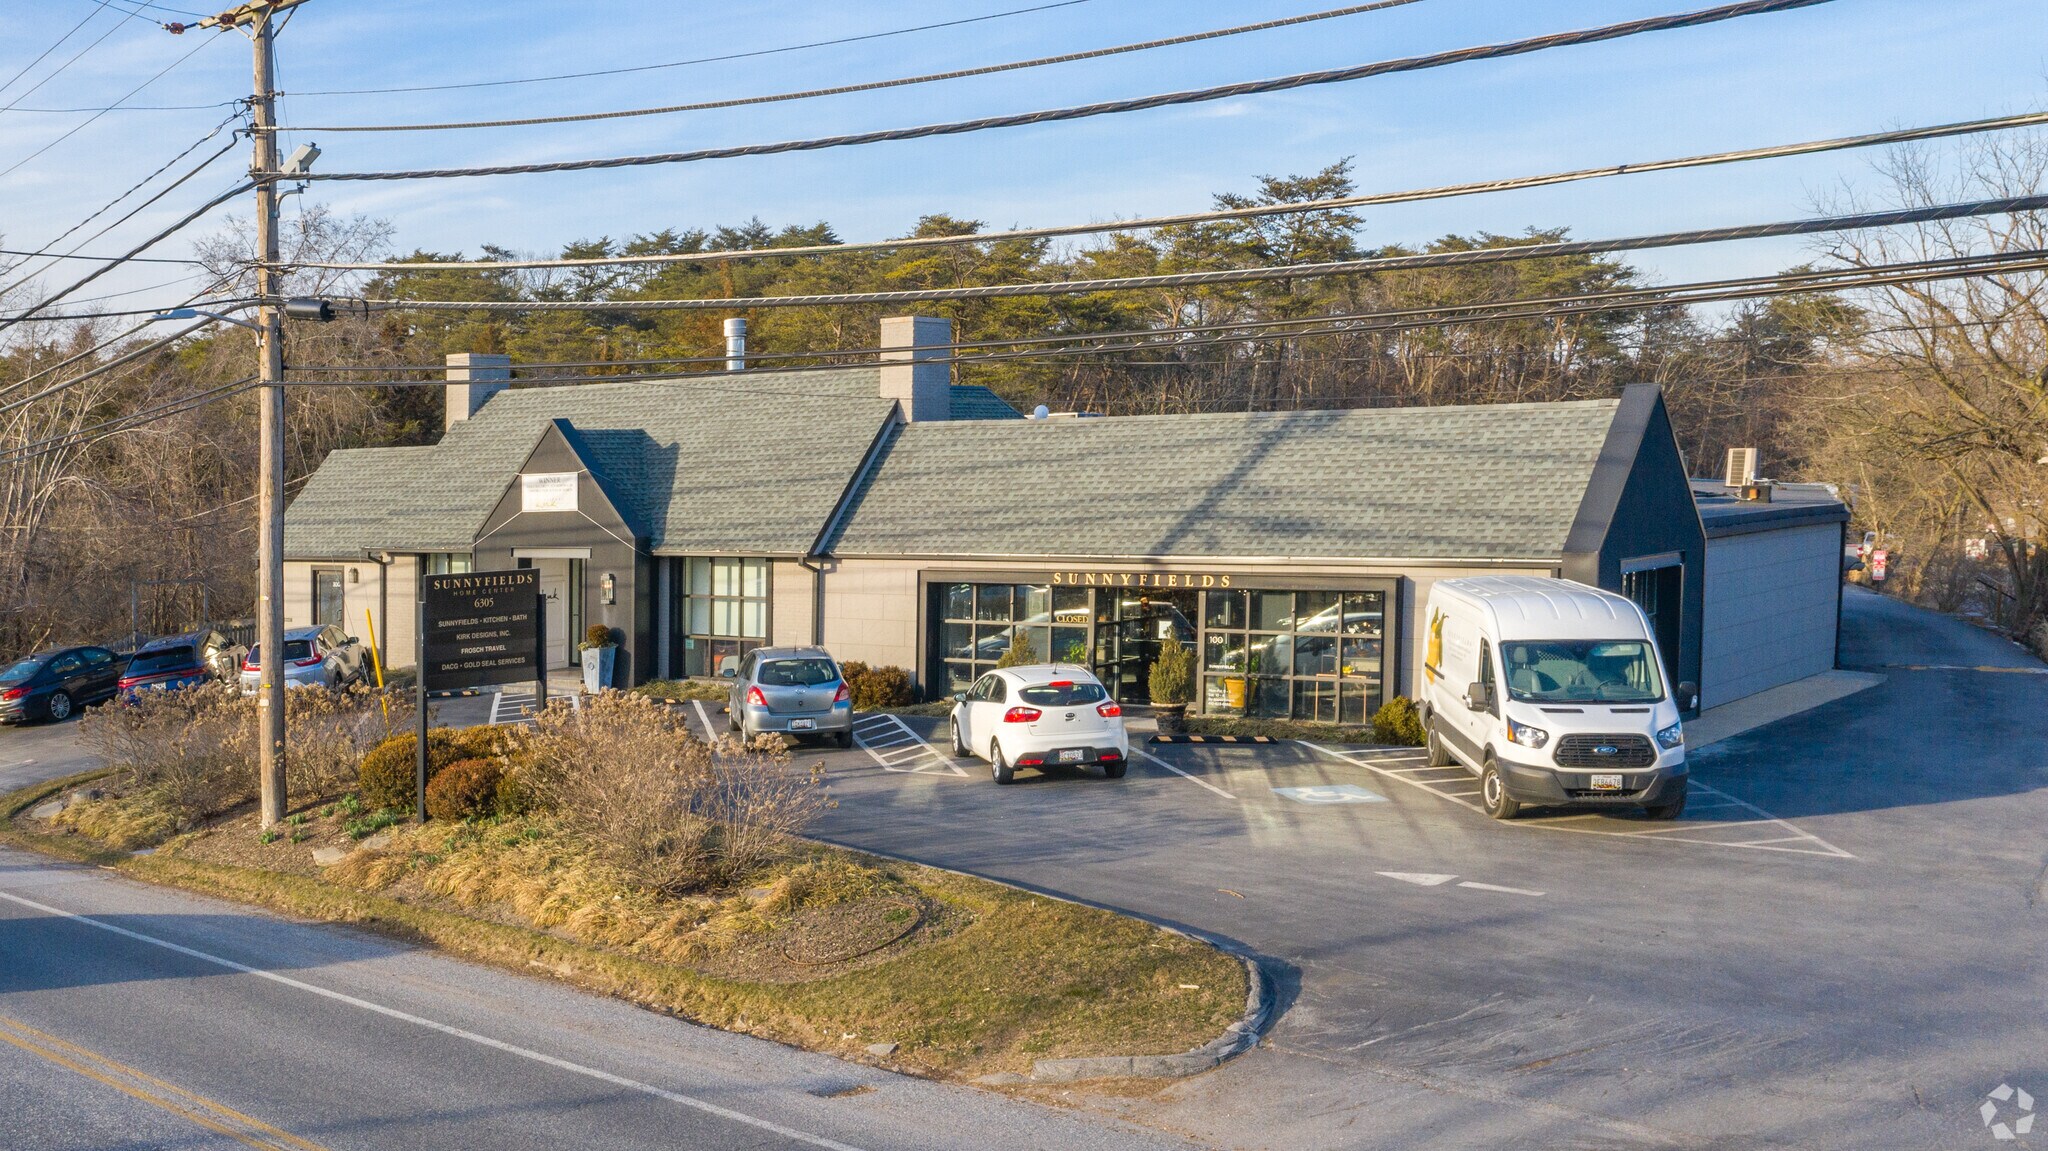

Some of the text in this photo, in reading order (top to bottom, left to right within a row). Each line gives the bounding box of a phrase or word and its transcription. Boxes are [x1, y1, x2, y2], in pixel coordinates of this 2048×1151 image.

[434, 574, 533, 590] SUNNYFIELDS
[1053, 572, 1230, 587] SUNNYFIELDS
[482, 587, 514, 595] CENTER
[474, 598, 494, 608] 6305
[438, 618, 478, 628] SUNNYFIELDS
[1056, 614, 1089, 623] CLOSED
[1209, 635, 1224, 644] 100
[498, 657, 526, 665] SERVICES
